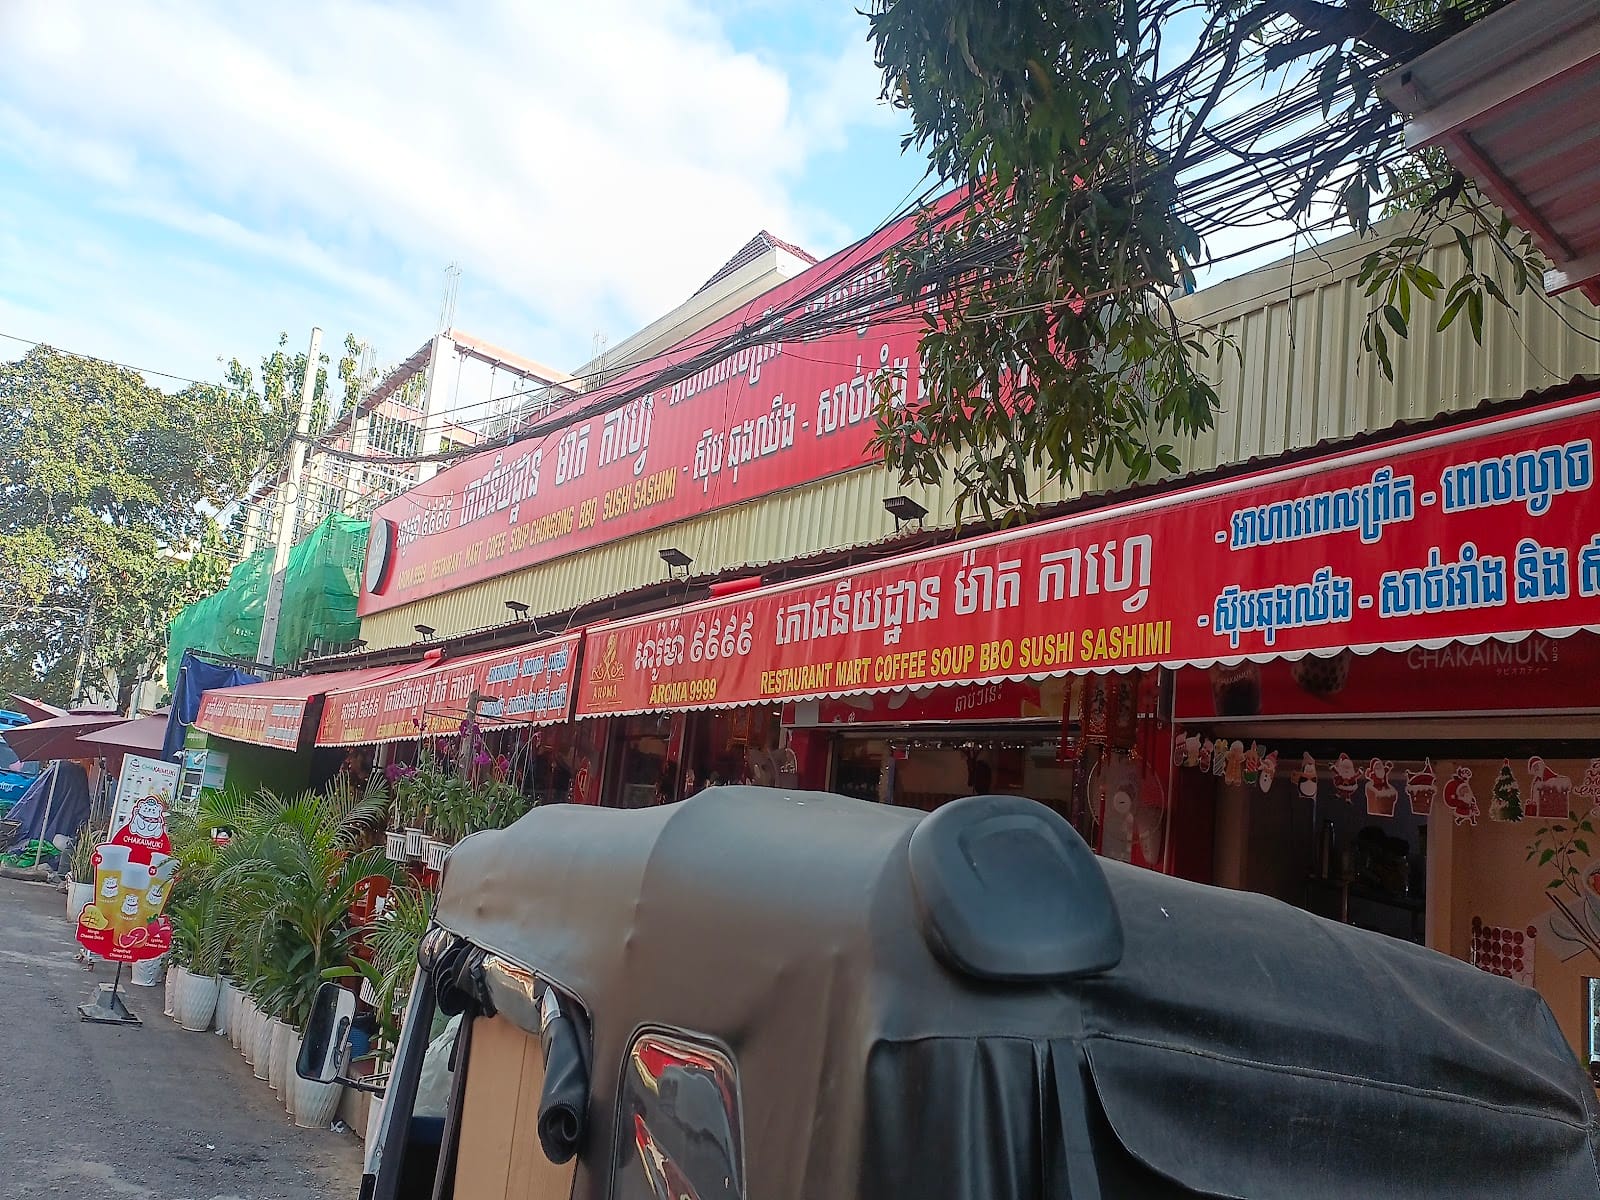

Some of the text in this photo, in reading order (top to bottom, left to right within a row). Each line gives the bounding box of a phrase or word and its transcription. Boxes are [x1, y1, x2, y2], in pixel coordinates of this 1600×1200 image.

[509, 523, 530, 553] SOUP
[578, 497, 598, 529] BBQ
[602, 482, 632, 521] SUSHI
[633, 466, 677, 511] SASHIMI
[1515, 538, 1570, 603] និង
[690, 611, 755, 663] ៩៩៩៩
[760, 662, 833, 695] RESTAURANT
[835, 657, 872, 688] MART
[874, 650, 927, 683] COFFEE
[930, 644, 974, 676] SOUP
[1019, 631, 1075, 668] SUSHI
[1080, 620, 1172, 662] SASHIMI
[649, 678, 717, 705] AROMA 9999
